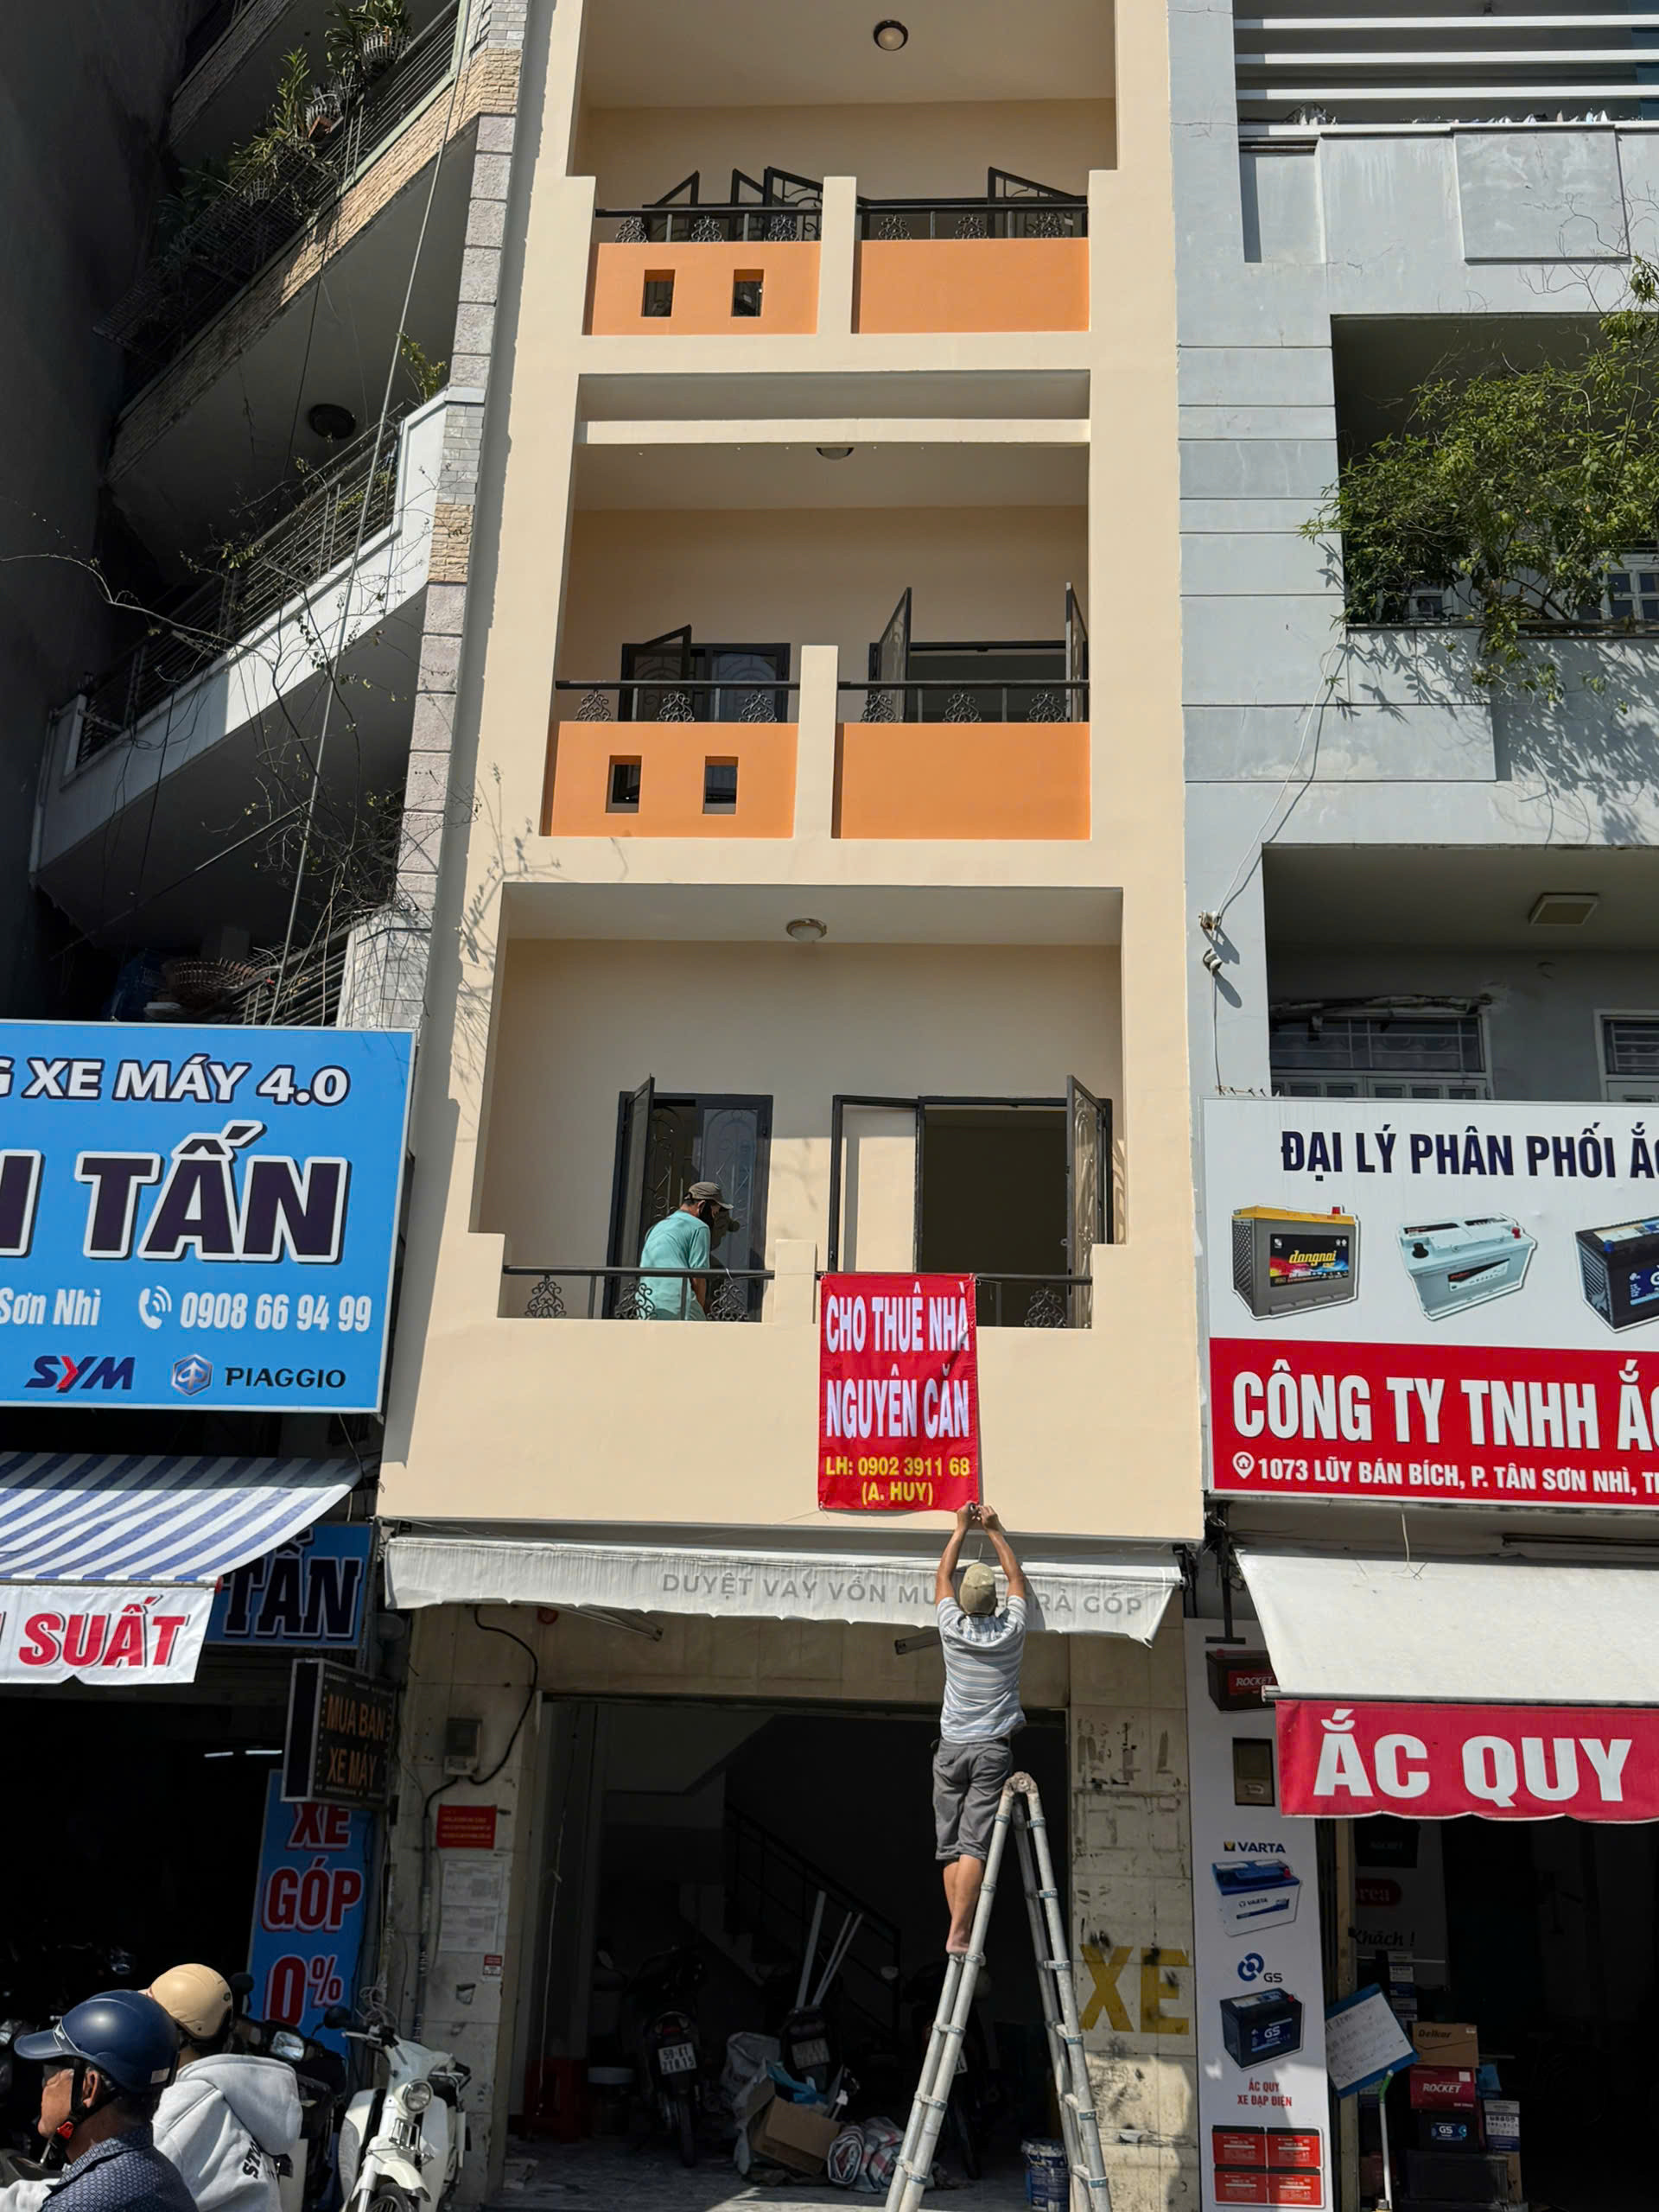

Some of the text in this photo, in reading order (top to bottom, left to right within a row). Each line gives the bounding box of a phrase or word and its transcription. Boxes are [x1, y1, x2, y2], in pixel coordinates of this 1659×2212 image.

[22, 1058, 103, 1099] XE
[114, 1055, 250, 1102] MÁY
[257, 1065, 351, 1104] 4.0
[1281, 1122, 1659, 1181] ĐẠI LÝ PHÂN PHỐI Ắ
[76, 1122, 348, 1262] TẤN
[54, 1287, 101, 1325] Nhì
[180, 1292, 372, 1332] 0908 66 94 99
[826, 1281, 969, 1353] CHO THUÊ NHÀ
[24, 1356, 346, 1393] SYM PIAGGIO
[826, 1363, 969, 1439] NGUYÊN CĂN
[1232, 1359, 1373, 1441] CÔNG
[1387, 1376, 1445, 1444] TY
[1461, 1380, 1599, 1450] TNHH
[825, 1456, 970, 1476] LH: 0902 3911 68
[1258, 1458, 1308, 1481] 1073
[1315, 1457, 1351, 1484] LŨY
[1359, 1457, 1402, 1484] BÁN
[1409, 1459, 1466, 1490] BÍCH,
[1471, 1465, 1490, 1488] P.
[1494, 1464, 1535, 1490] TÂN
[1542, 1466, 1587, 1491] SƠN
[1593, 1466, 1637, 1496] NHÌ,
[861, 1482, 934, 1506] (A. HUY)
[222, 1527, 362, 1637] TẤN
[663, 1573, 753, 1599] DUYỆT
[763, 1579, 817, 1599] VAY
[828, 1576, 886, 1603] VỐN
[898, 1586, 937, 1605] MU
[1029, 1588, 1072, 1611] RẢ
[1084, 1591, 1141, 1615] GÓP
[18, 1596, 190, 1668] SUẤT
[1236, 1675, 1273, 1687] ROCKET
[326, 1694, 357, 1735] MUA
[326, 1745, 346, 1783] XE
[1313, 1708, 1632, 1808] ẮC QUY
[287, 1804, 350, 1850] XE
[1238, 1842, 1286, 1853] VARTA
[263, 1854, 364, 1933] GÓP
[264, 1954, 343, 2026] 0%
[1079, 1944, 1190, 2035] XE
[1263, 1973, 1283, 1984] GS
[1264, 2026, 1281, 2038] GS
[1237, 2094, 1249, 2105] XE
[1423, 2083, 1461, 2094] ROCKET
[1439, 2126, 1453, 2134] GS
